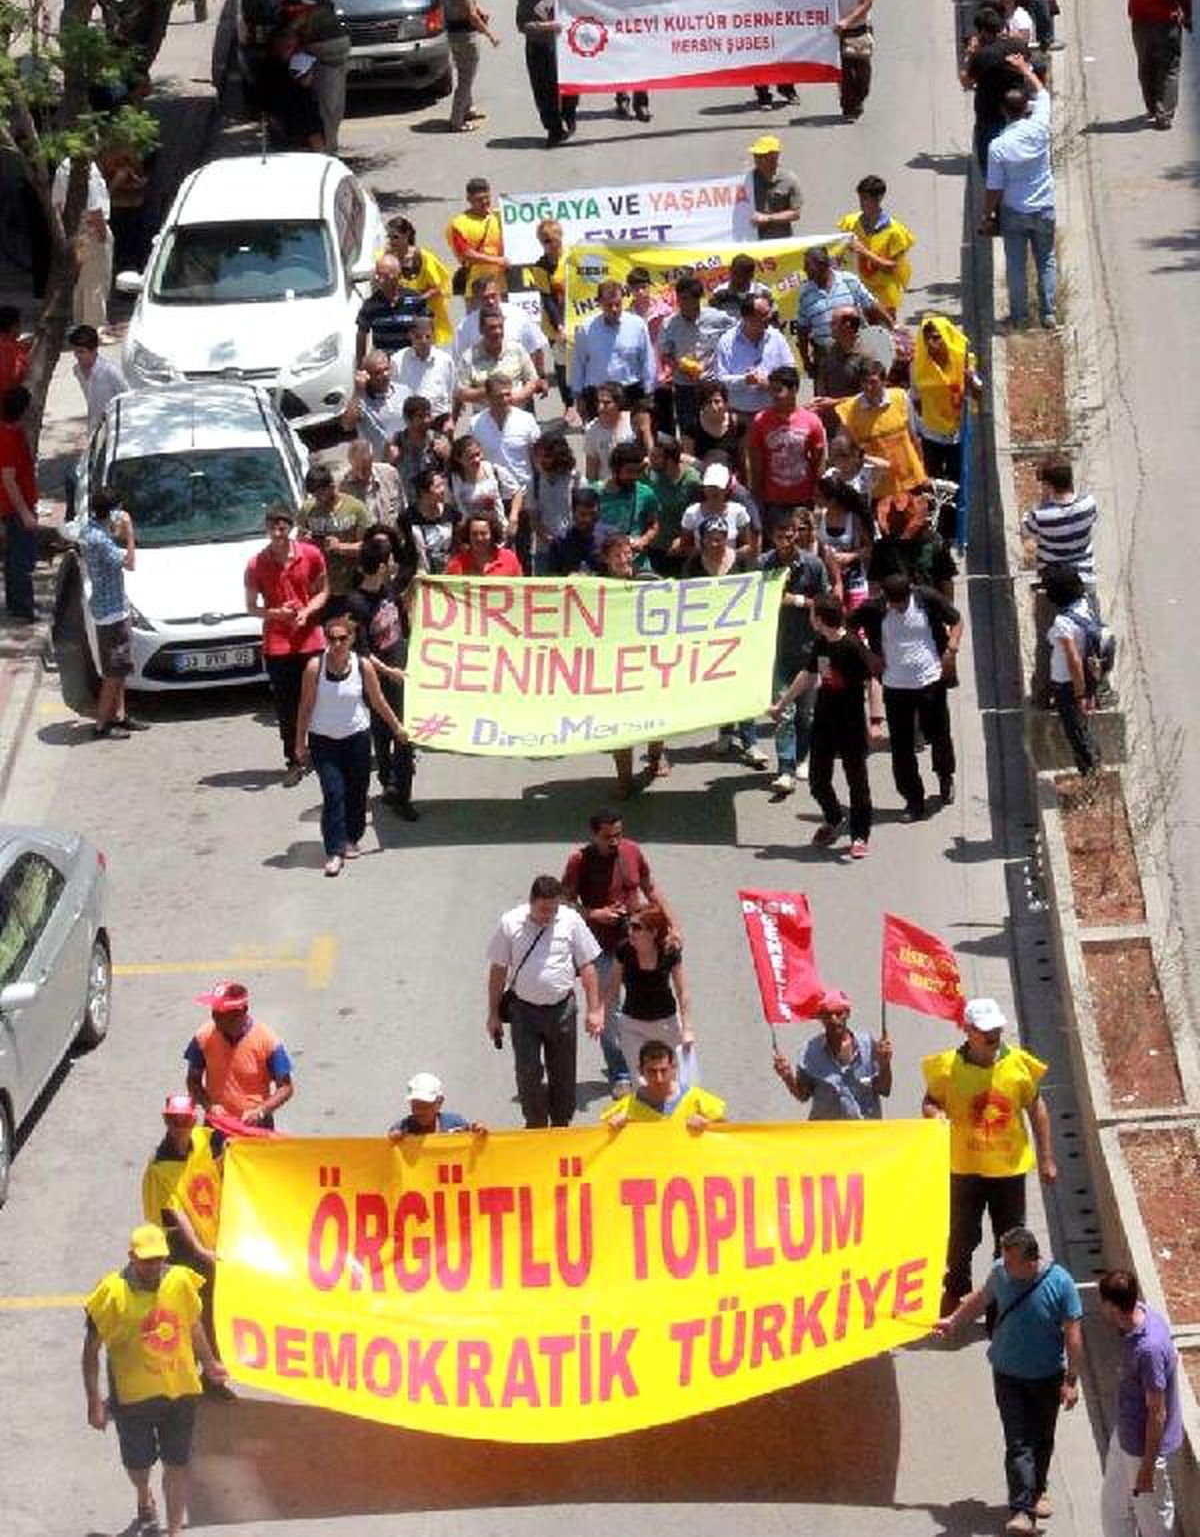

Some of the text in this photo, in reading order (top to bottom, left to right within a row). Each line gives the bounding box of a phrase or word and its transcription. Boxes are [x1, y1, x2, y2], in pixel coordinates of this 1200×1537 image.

[615, 14, 659, 34] ALEVİ
[733, 6, 829, 30] DERNEKLERİ
[503, 186, 748, 226] DOĞAYA VE YAŞAMA
[418, 636, 742, 696] SENİNLEYİZ
[307, 1156, 866, 1294] ÖRGÜTLÜ TOPLUM
[230, 1255, 930, 1408] DEMOKRATİK TÜRKİYE
